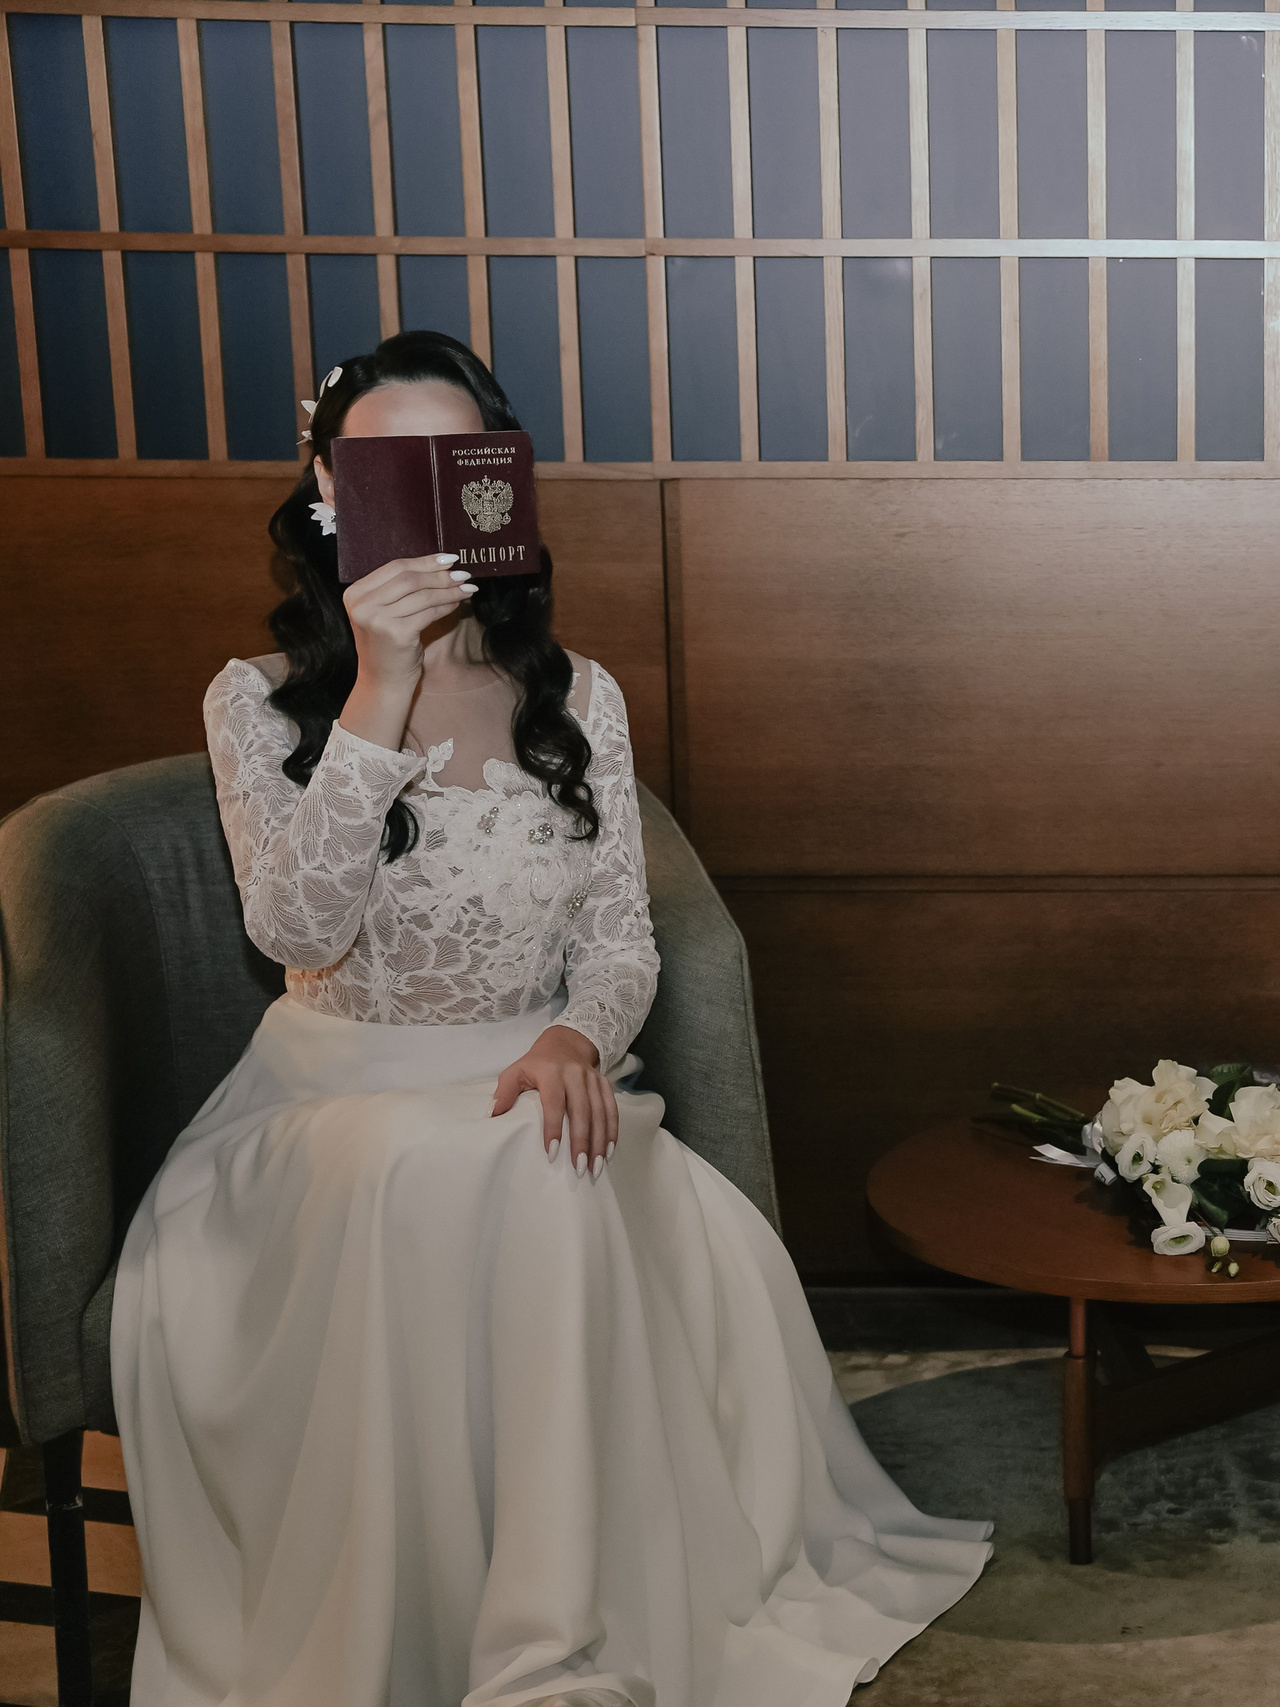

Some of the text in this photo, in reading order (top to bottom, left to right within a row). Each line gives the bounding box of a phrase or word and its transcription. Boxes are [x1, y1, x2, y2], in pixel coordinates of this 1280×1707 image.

[452, 446, 517, 456] РОССИЙСКАЯ
[457, 457, 513, 466] ФЕДЕРАЦИЯ
[459, 545, 526, 564] ПАСПОРТ
